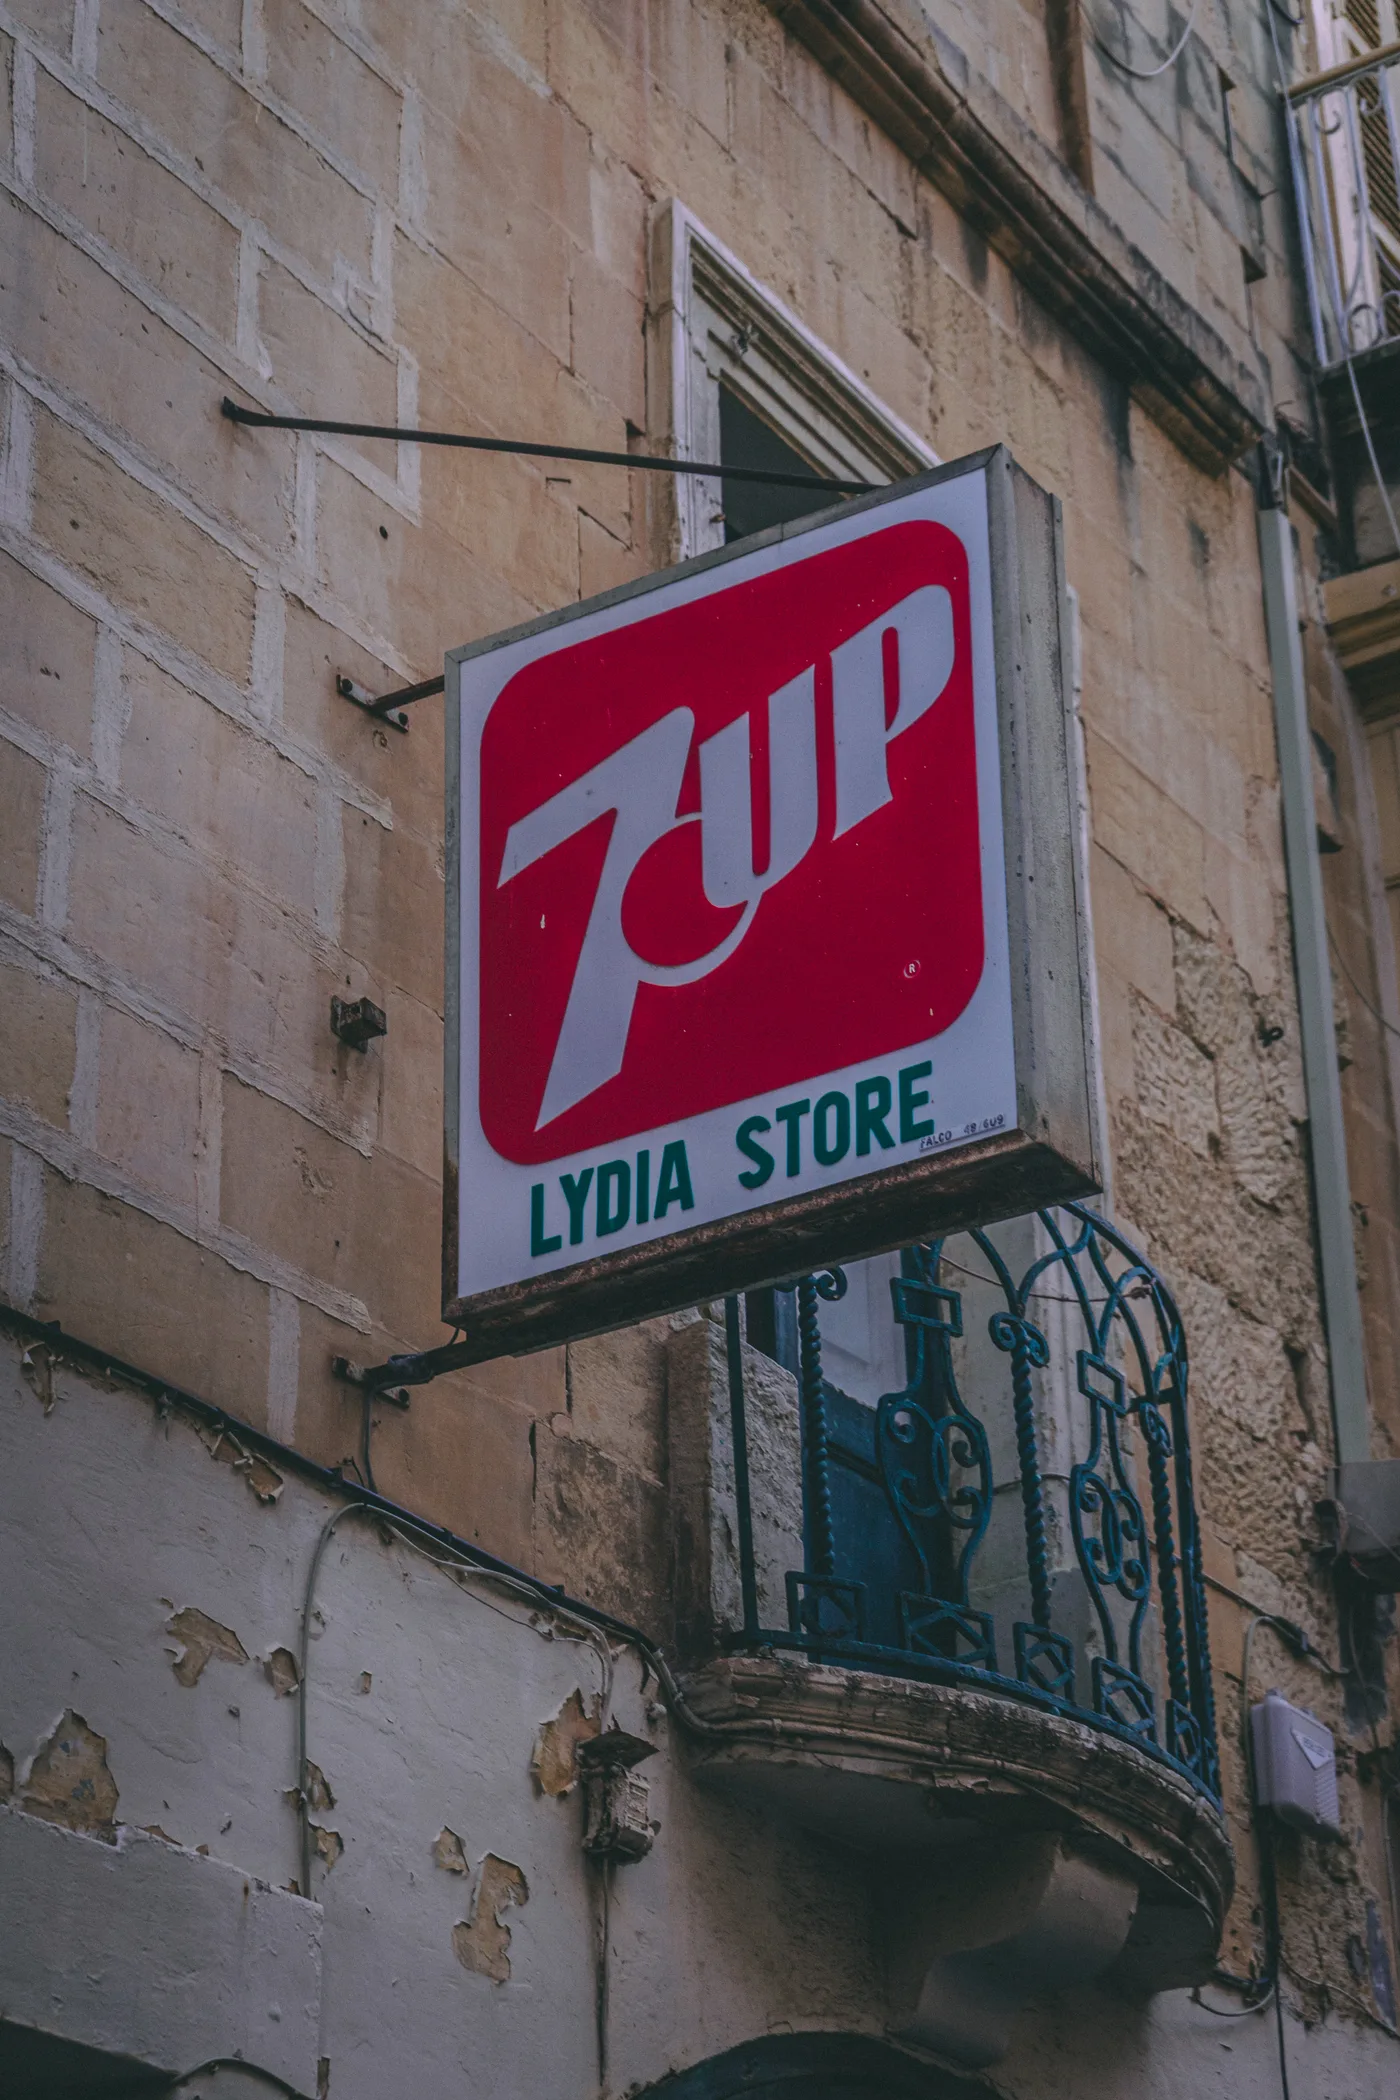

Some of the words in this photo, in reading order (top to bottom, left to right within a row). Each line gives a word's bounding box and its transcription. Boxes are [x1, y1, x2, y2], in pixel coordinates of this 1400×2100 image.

[497, 584, 955, 1132] 7UP
[530, 1139, 695, 1257] LYDIA
[735, 1059, 935, 1189] STORE
